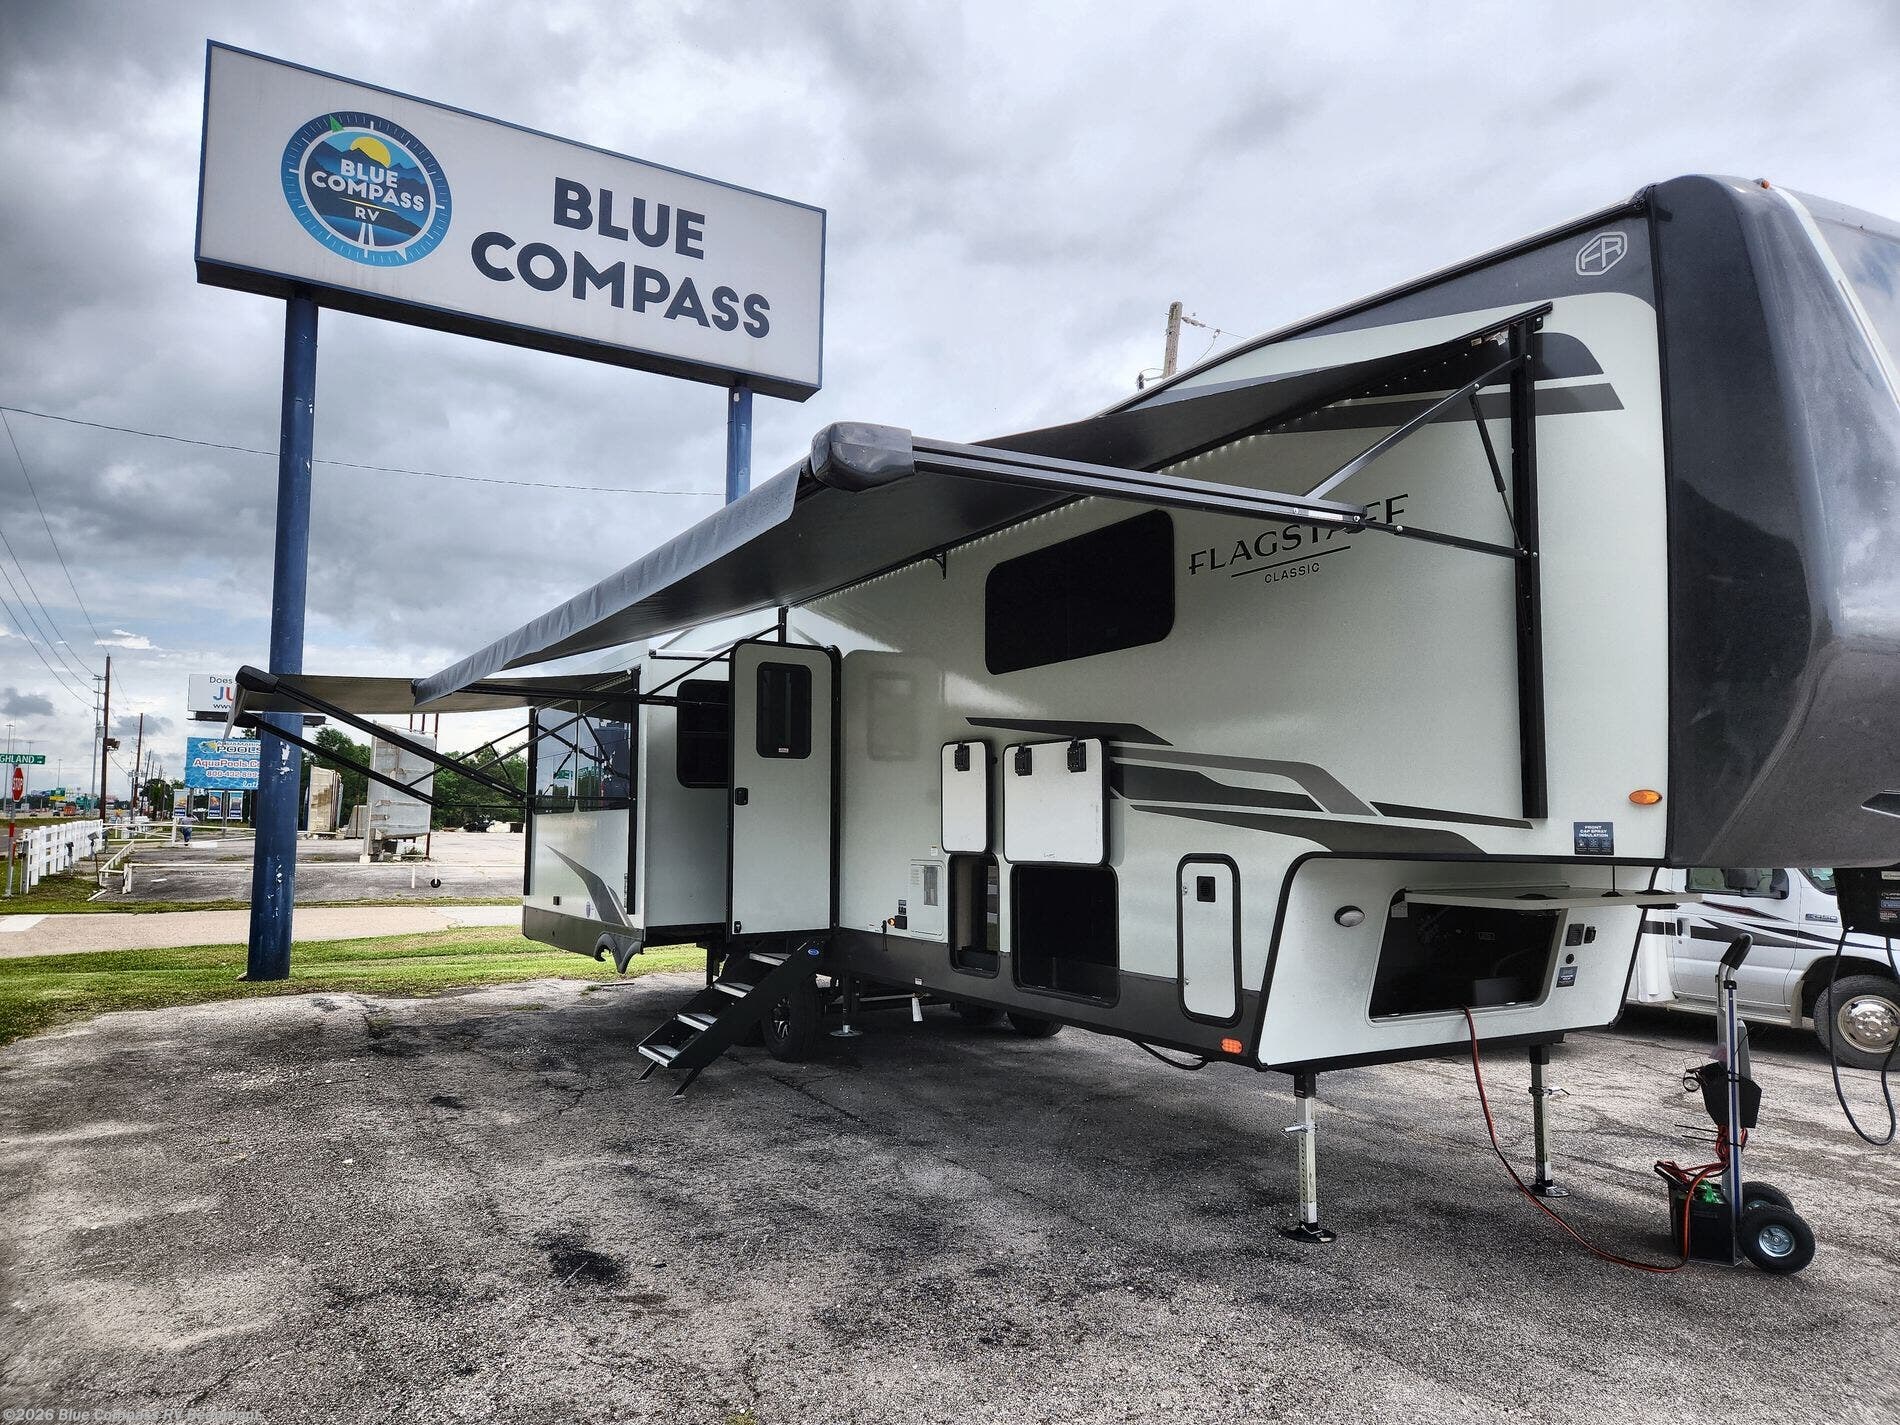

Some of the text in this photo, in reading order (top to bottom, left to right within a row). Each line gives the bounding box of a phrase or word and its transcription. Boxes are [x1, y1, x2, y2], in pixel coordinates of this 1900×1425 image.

[311, 170, 424, 212] COMPASS
[341, 158, 399, 189] BLUE
[355, 205, 380, 222] RV
[553, 176, 705, 260] BLUE
[471, 231, 771, 339] COMPASS
[1188, 493, 1409, 575] FLAGSTF
[1264, 562, 1320, 584] CLASSIC
